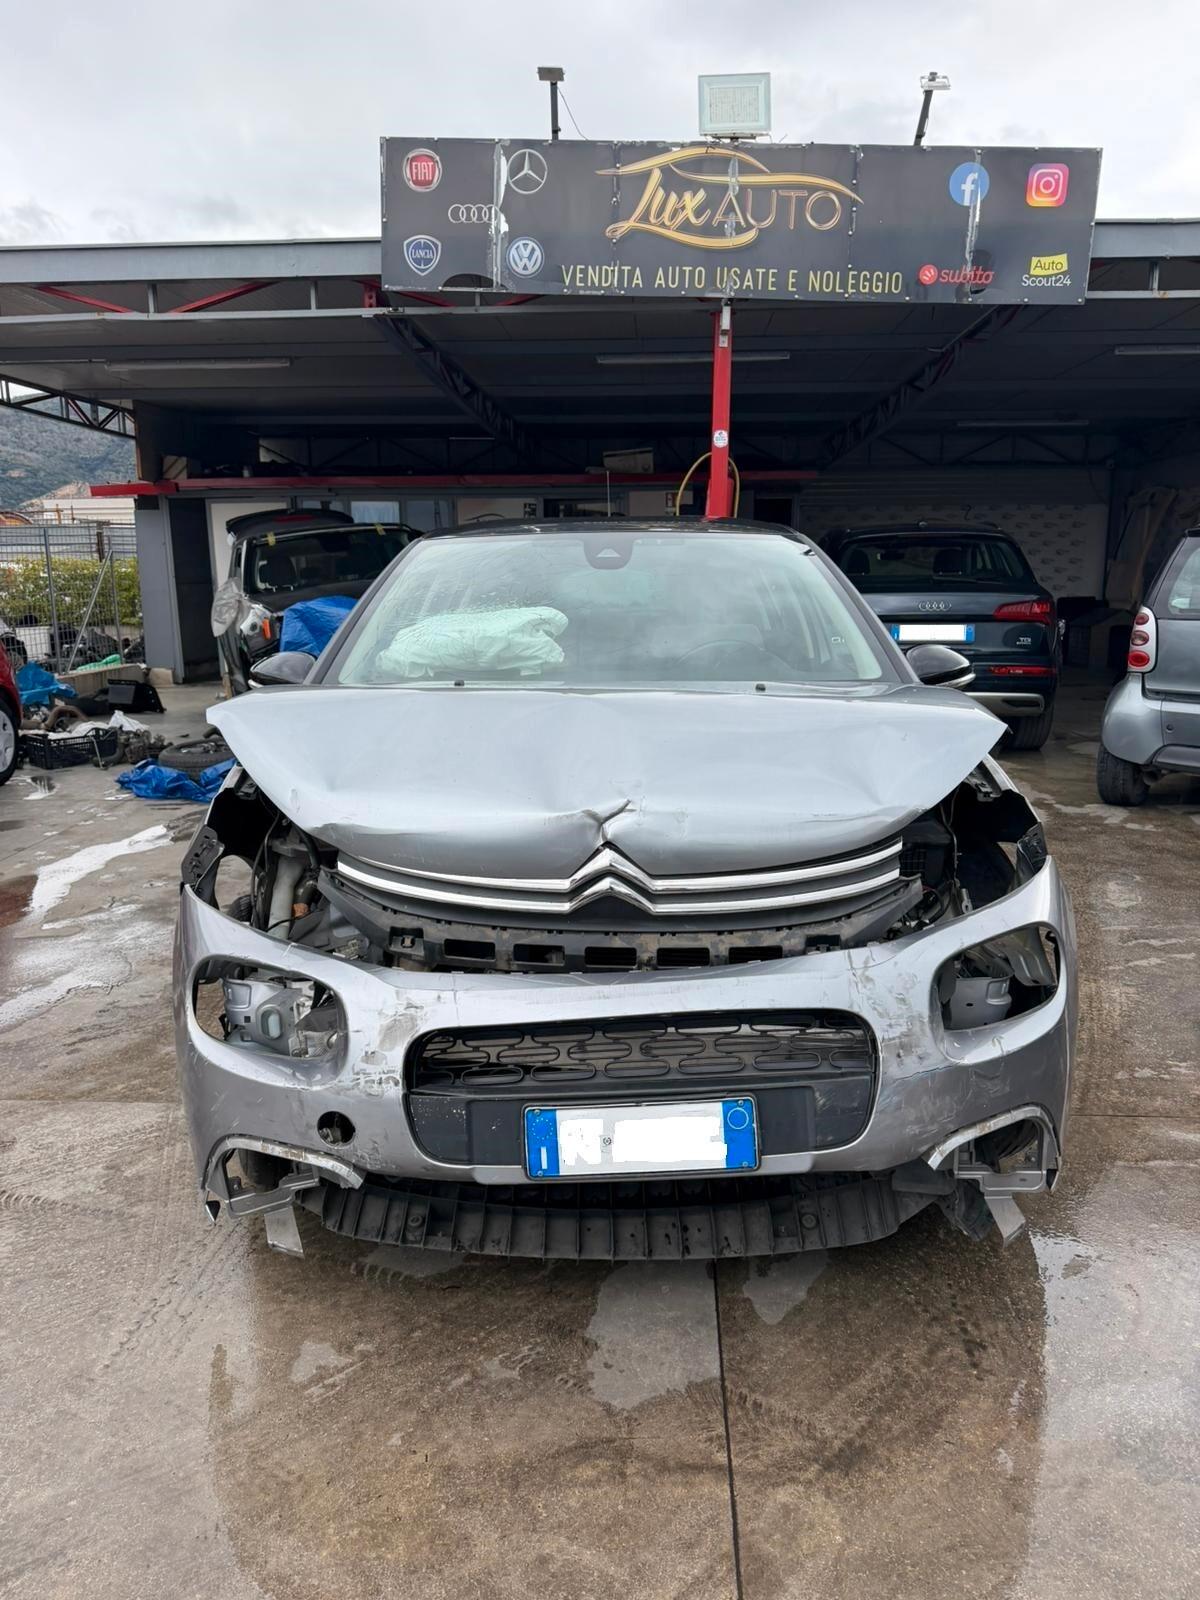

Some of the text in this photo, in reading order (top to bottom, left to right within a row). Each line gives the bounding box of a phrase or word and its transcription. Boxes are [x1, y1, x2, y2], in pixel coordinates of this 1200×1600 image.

[411, 160, 434, 181] FIAT
[606, 167, 842, 240] Lux AUTO
[411, 248, 434, 260] LANCIA
[939, 265, 994, 285] subito
[1032, 258, 1065, 272] Auto
[561, 264, 903, 294] VENDITA AUTO USATE E NOLEGGIO
[1021, 274, 1072, 287] Scout24
